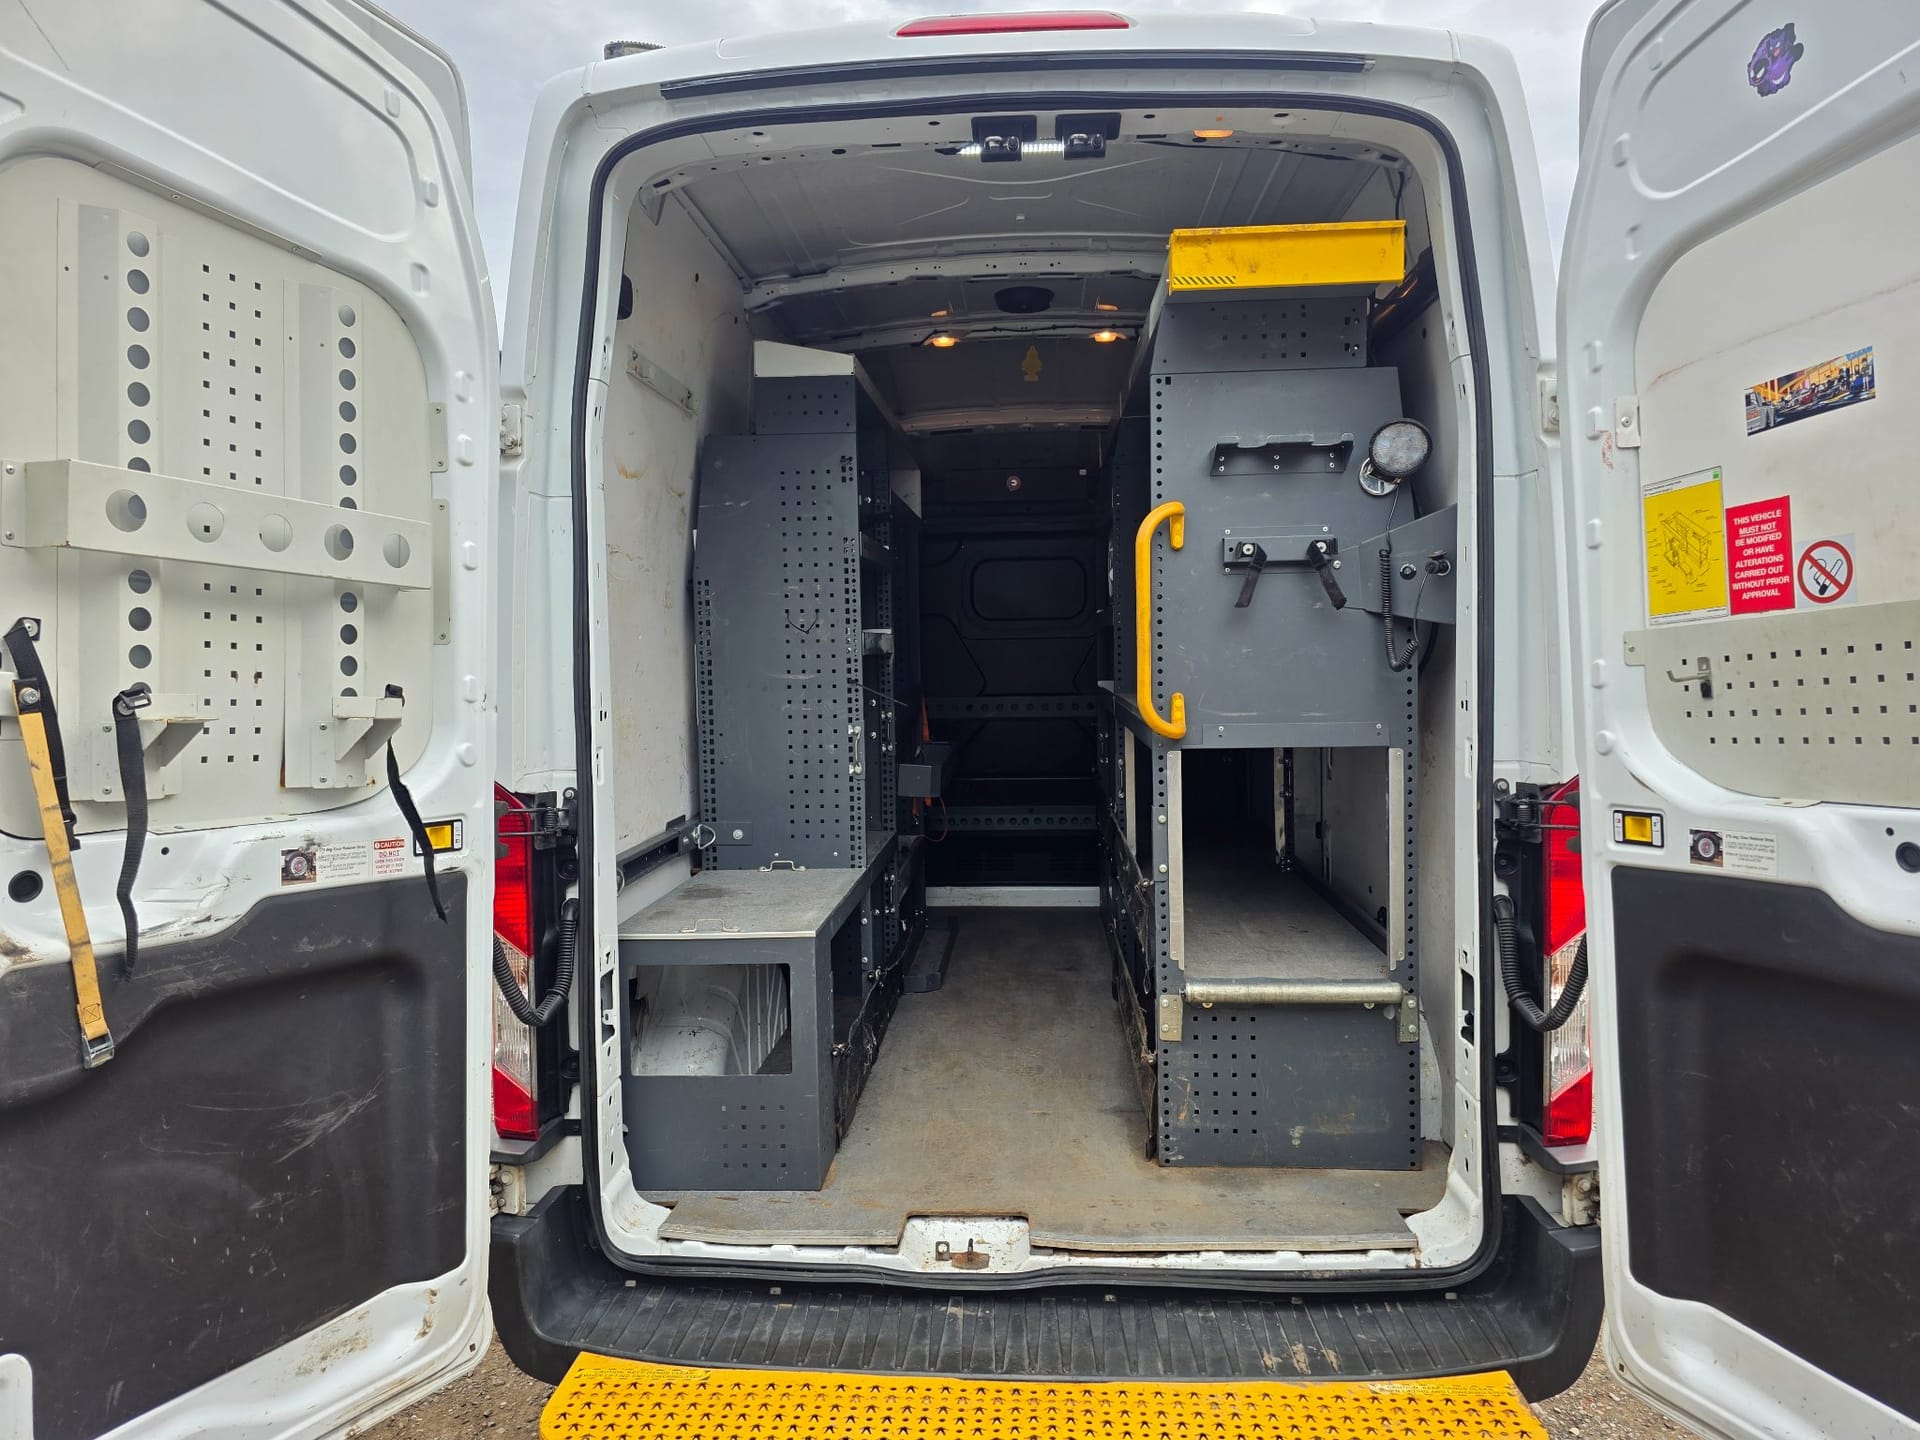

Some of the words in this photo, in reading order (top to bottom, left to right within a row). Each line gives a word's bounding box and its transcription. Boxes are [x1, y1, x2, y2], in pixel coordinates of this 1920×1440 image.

[1733, 516, 1750, 526] THIS
[1750, 509, 1782, 523] VEHICLE
[1739, 525, 1760, 535] MUST
[1761, 522, 1776, 532] NOT
[1735, 537, 1745, 547] BE
[1746, 532, 1782, 546] MODIFIED
[1743, 547, 1755, 556] OR
[1755, 544, 1775, 555] HAVE
[1735, 554, 1784, 568] ALTERATIONS
[1734, 567, 1767, 580] CARRIED
[1768, 565, 1784, 575] OUT
[1732, 579, 1765, 591] WITHOUT
[1766, 576, 1790, 586] PRIOR
[1742, 588, 1780, 600] APPROVAL
[380, 840, 405, 849] CAUTION
